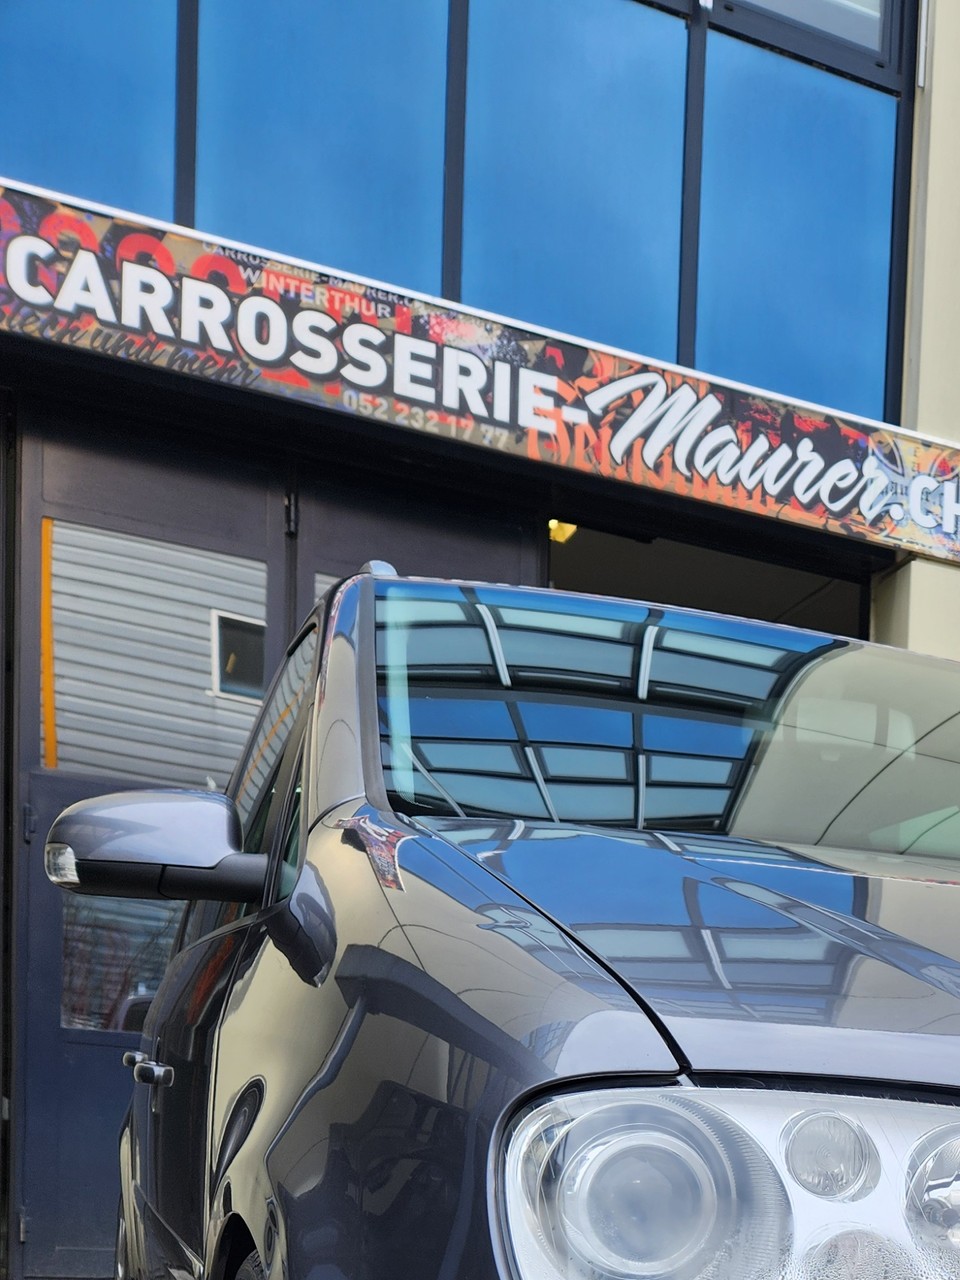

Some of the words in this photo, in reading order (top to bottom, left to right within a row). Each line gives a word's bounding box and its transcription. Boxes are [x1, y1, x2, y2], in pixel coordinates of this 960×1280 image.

[238, 264, 392, 319] WINTERTHUR
[342, 389, 389, 420] 052
[395, 401, 440, 433] 232
